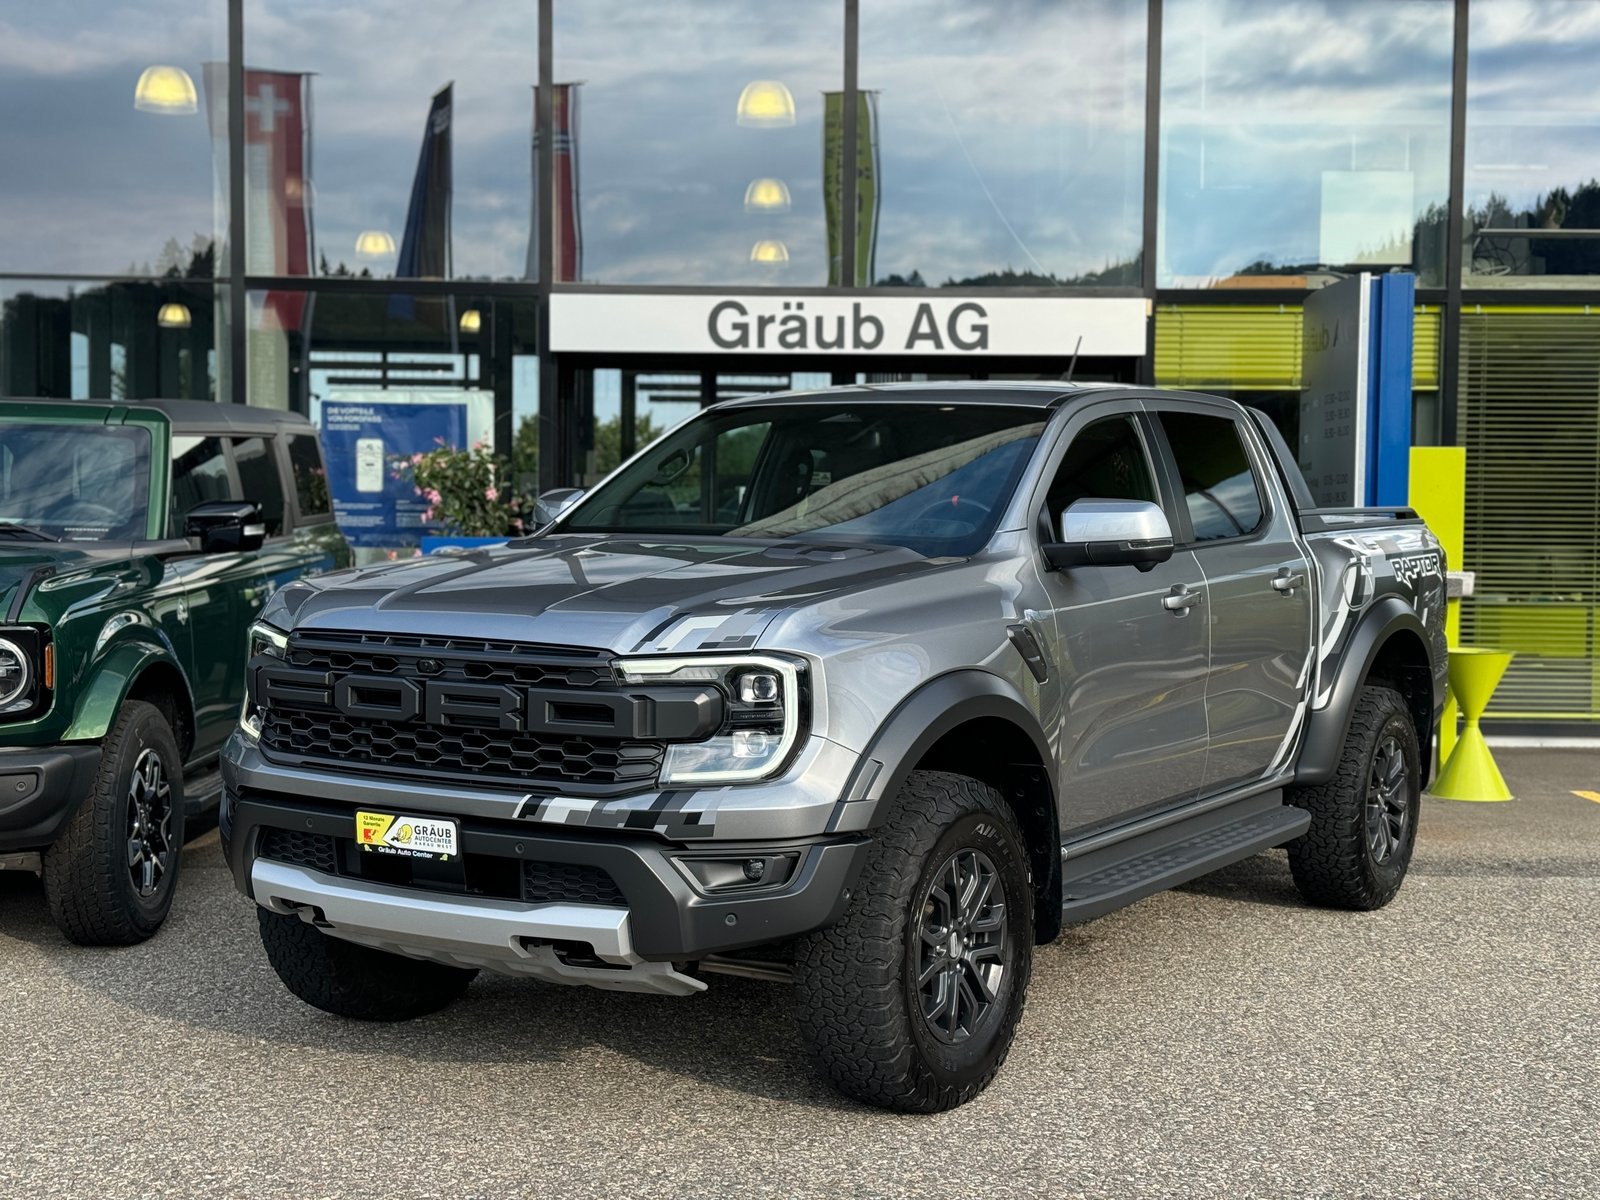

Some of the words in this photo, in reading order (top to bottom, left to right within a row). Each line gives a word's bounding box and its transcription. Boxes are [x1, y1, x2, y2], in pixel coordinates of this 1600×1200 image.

[707, 300, 884, 350] Gräub
[904, 302, 989, 351] AG
[1389, 553, 1443, 590] RAPTOR
[256, 666, 656, 739] FORD
[414, 824, 451, 838] GRÄUB
[414, 835, 452, 845] AUTOCENTER
[378, 846, 396, 854] Gräub
[397, 848, 412, 856] Auto
[412, 850, 433, 858] Center
